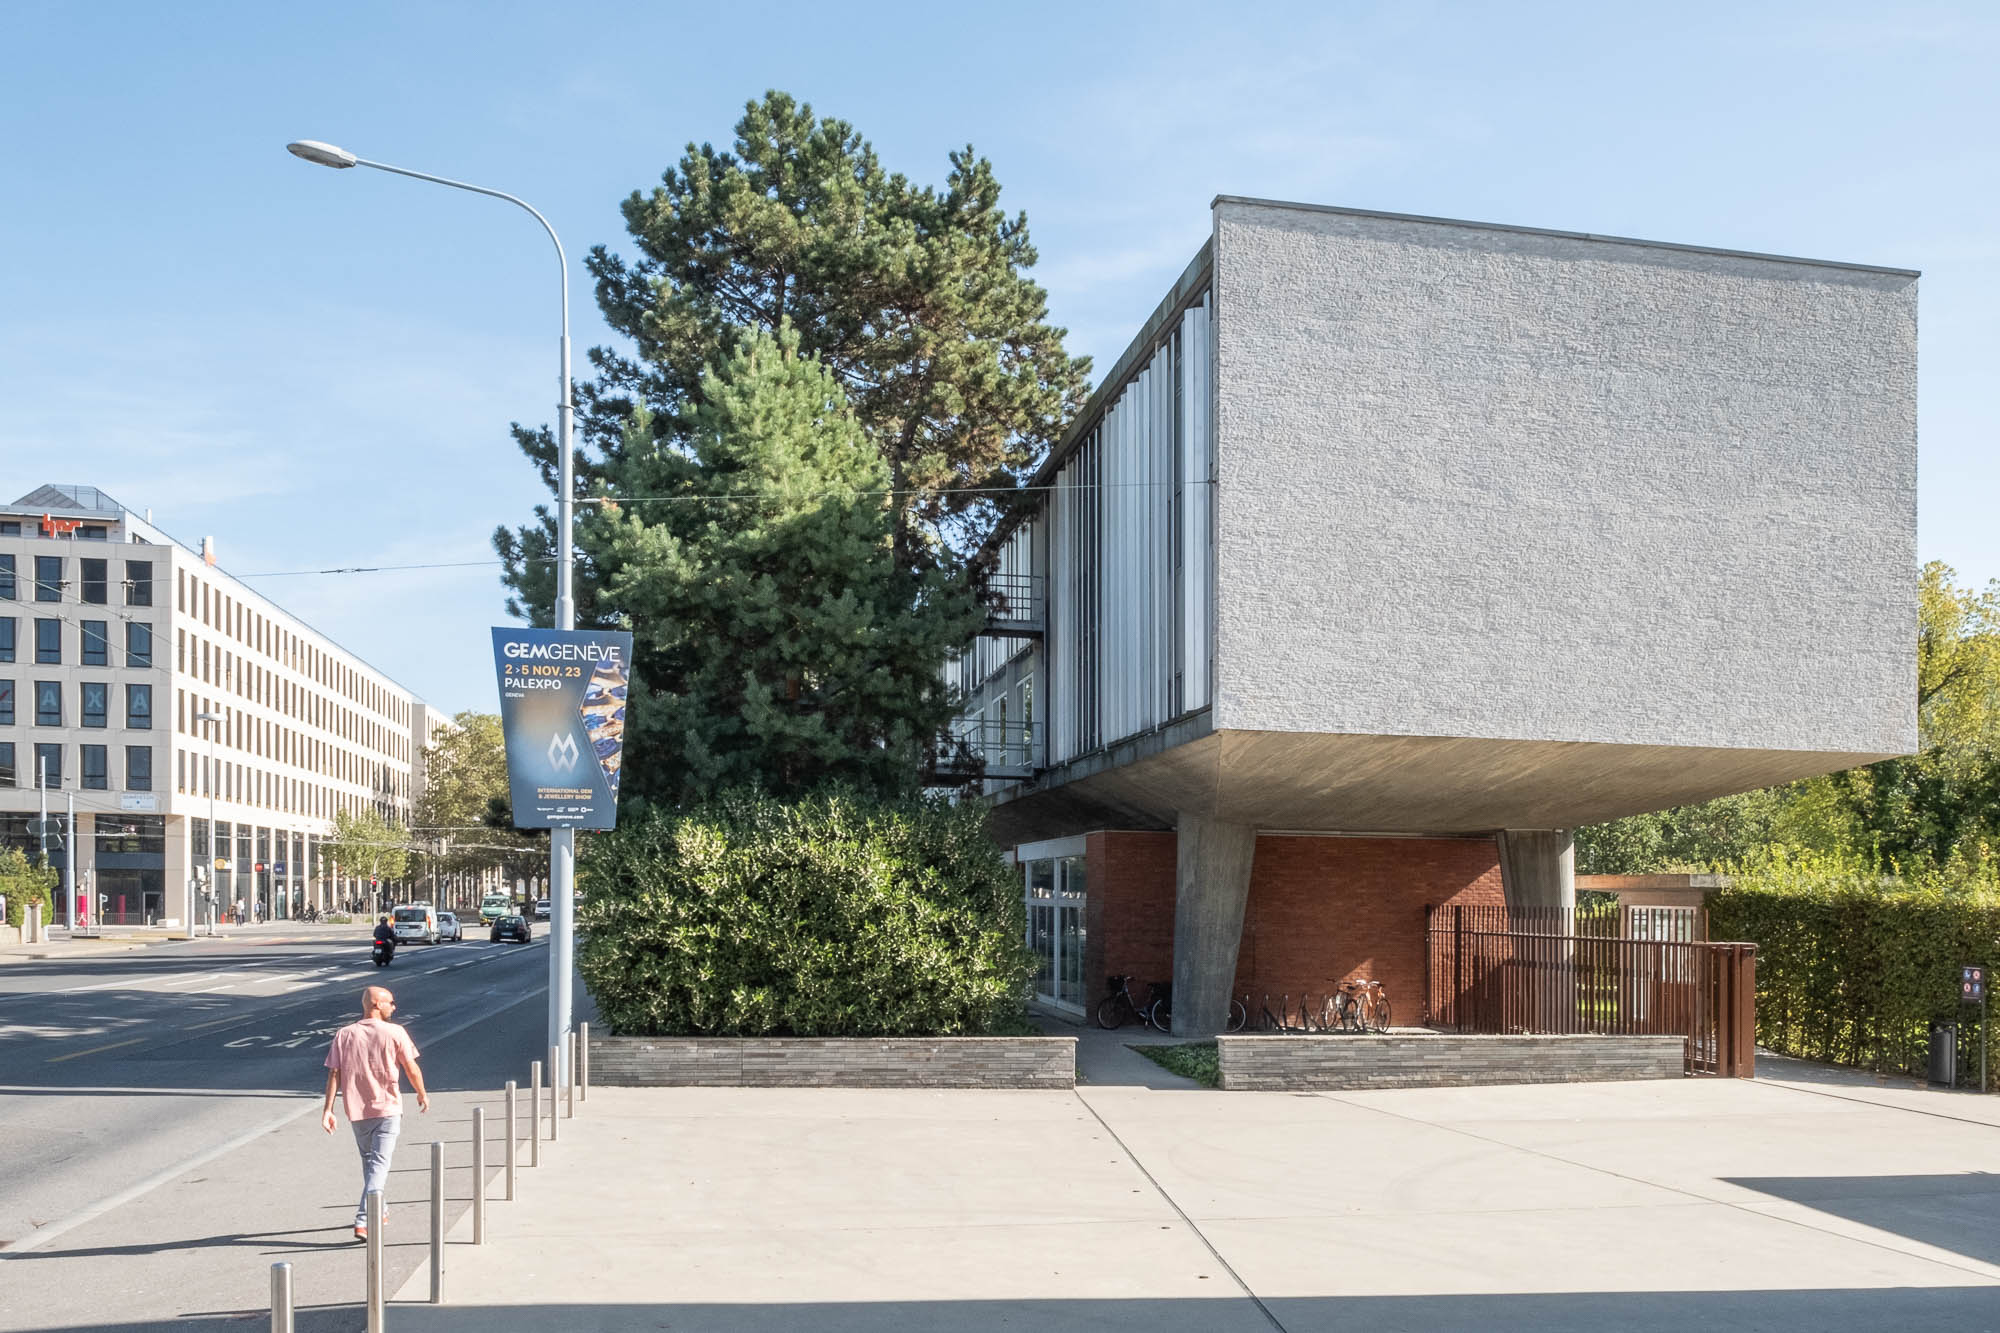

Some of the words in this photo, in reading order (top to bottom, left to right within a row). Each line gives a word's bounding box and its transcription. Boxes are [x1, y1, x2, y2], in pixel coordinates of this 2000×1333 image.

[503, 641, 620, 662] GEMGENÈVE
[505, 664, 513, 675] 2
[521, 665, 529, 675] 5
[533, 665, 562, 677] NOV.
[565, 667, 581, 677] 23
[505, 677, 562, 690] PALEXPO
